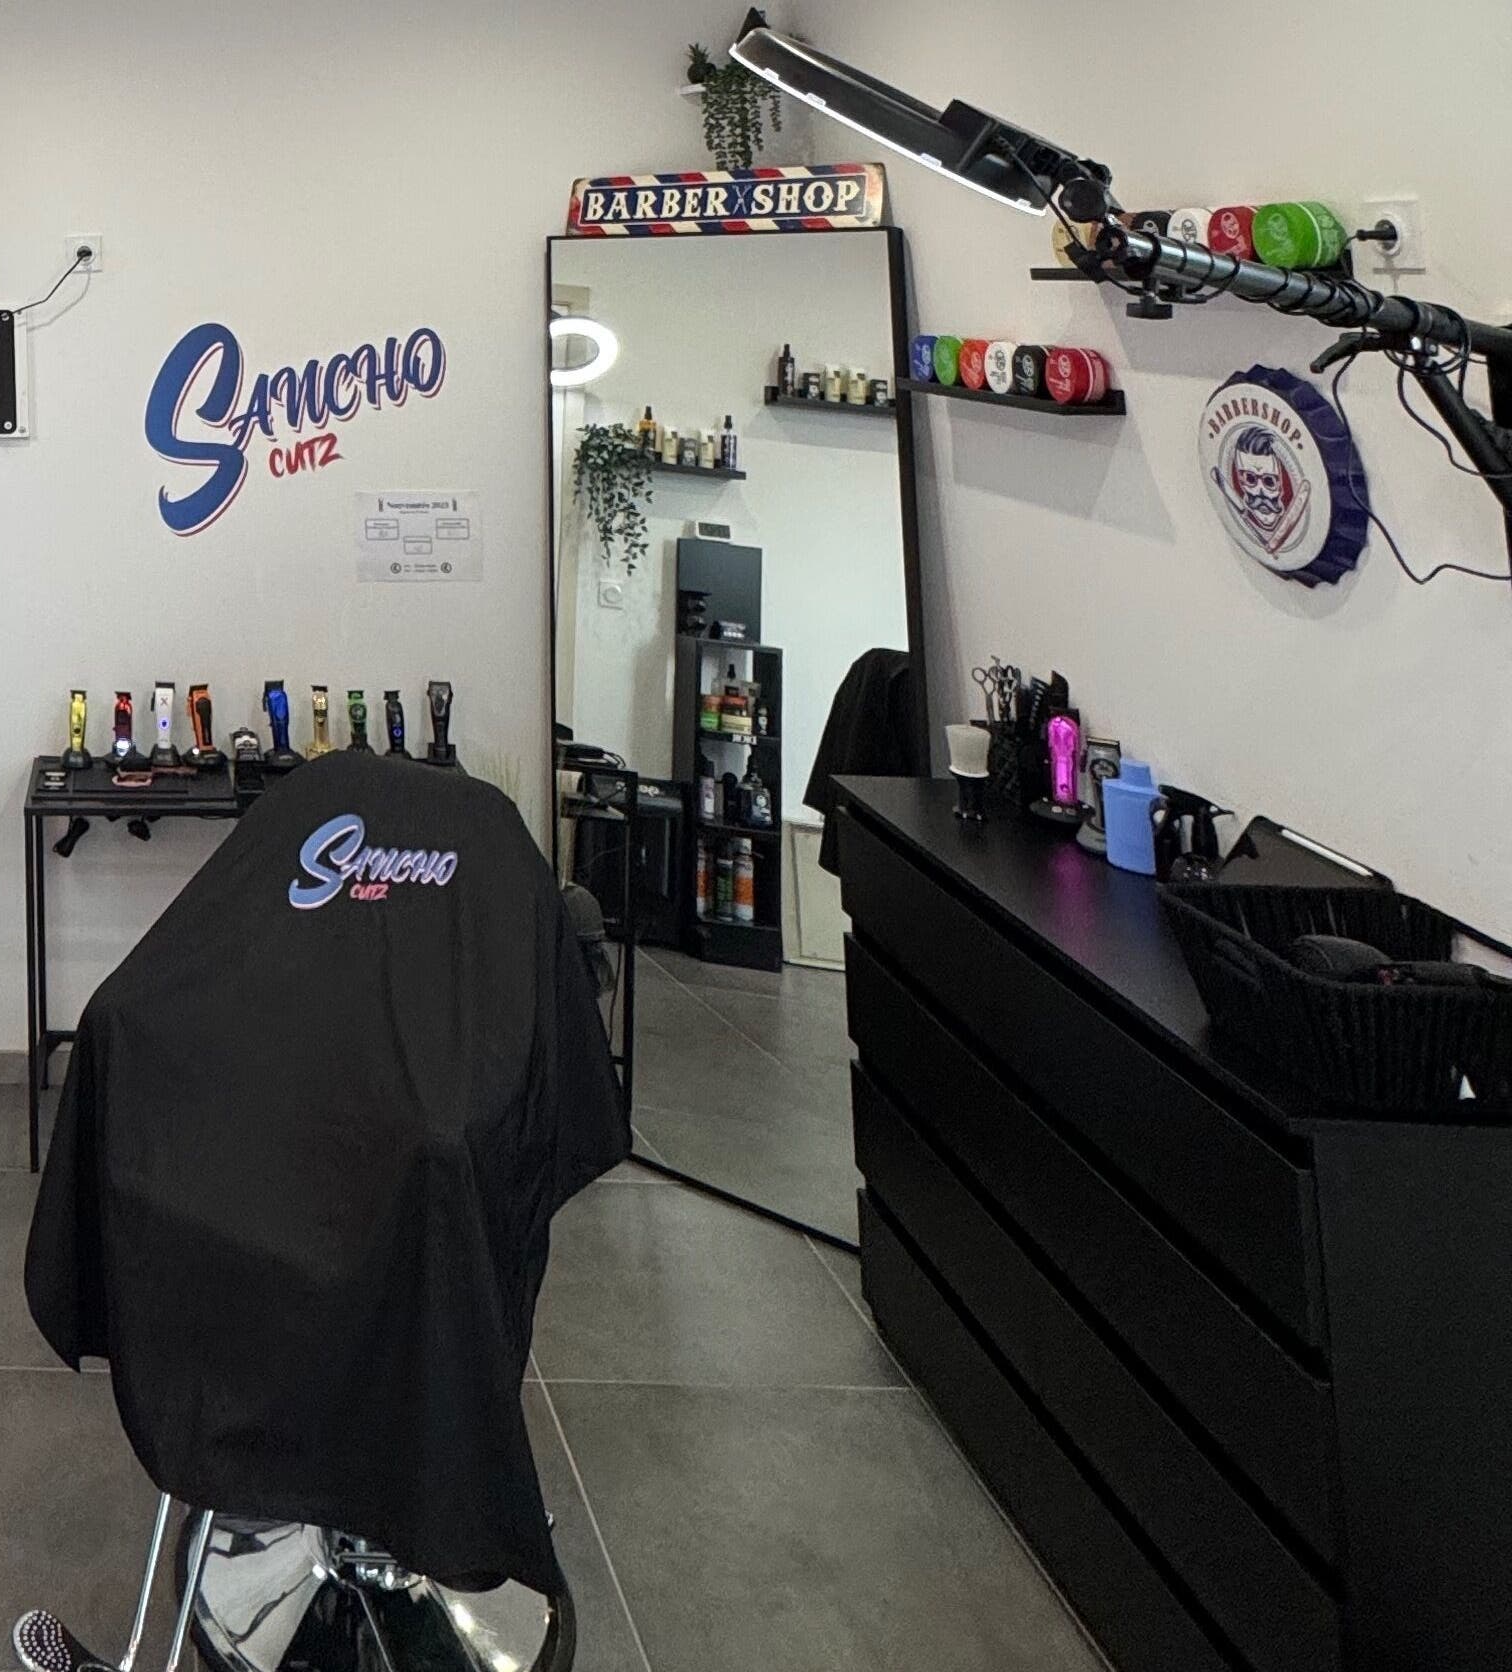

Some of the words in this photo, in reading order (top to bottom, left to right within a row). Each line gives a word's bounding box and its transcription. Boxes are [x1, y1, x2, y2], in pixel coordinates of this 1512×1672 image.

[584, 188, 729, 221] BARBER
[750, 180, 861, 214] SHOP
[144, 321, 447, 537] SANCHO
[1208, 397, 1301, 442] BARBERSHOP
[268, 432, 343, 478] CUTZ
[288, 813, 458, 910] SANCHO
[349, 883, 389, 900] CUTZ
